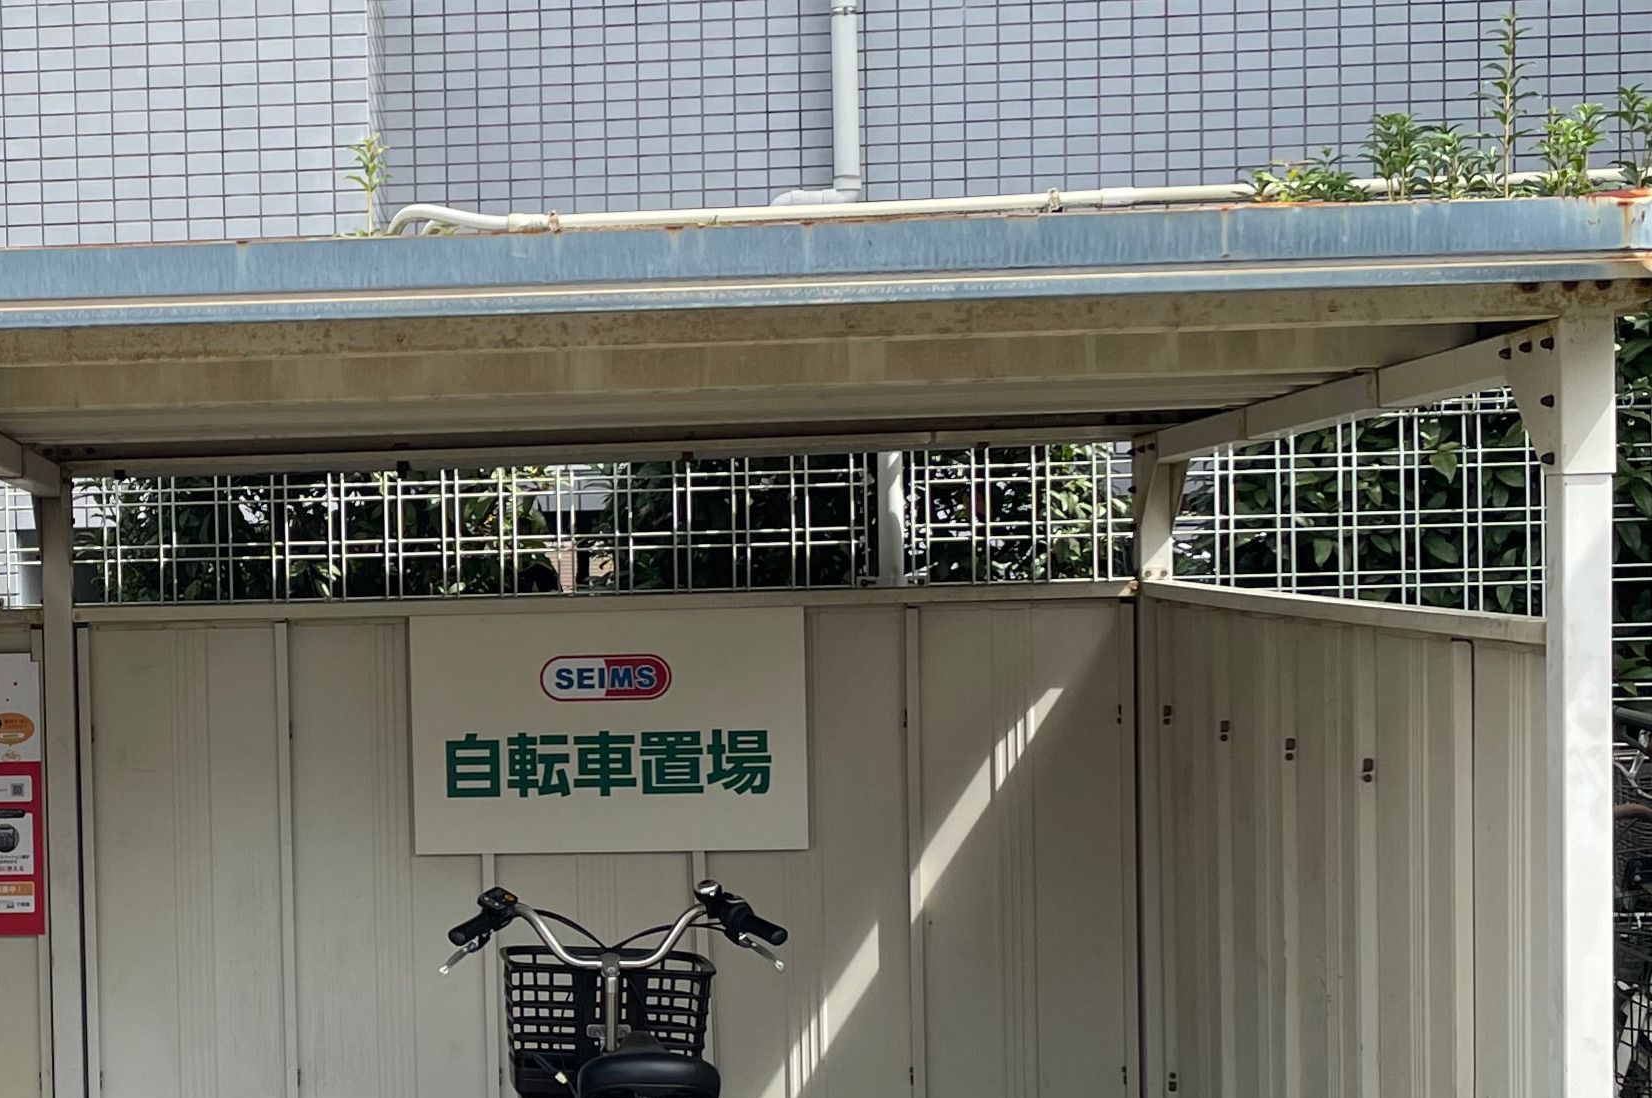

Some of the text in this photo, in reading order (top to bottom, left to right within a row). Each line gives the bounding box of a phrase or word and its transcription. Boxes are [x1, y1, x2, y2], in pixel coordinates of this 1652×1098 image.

[554, 664, 658, 691] SEIMS
[444, 729, 773, 799] 自転車置場
